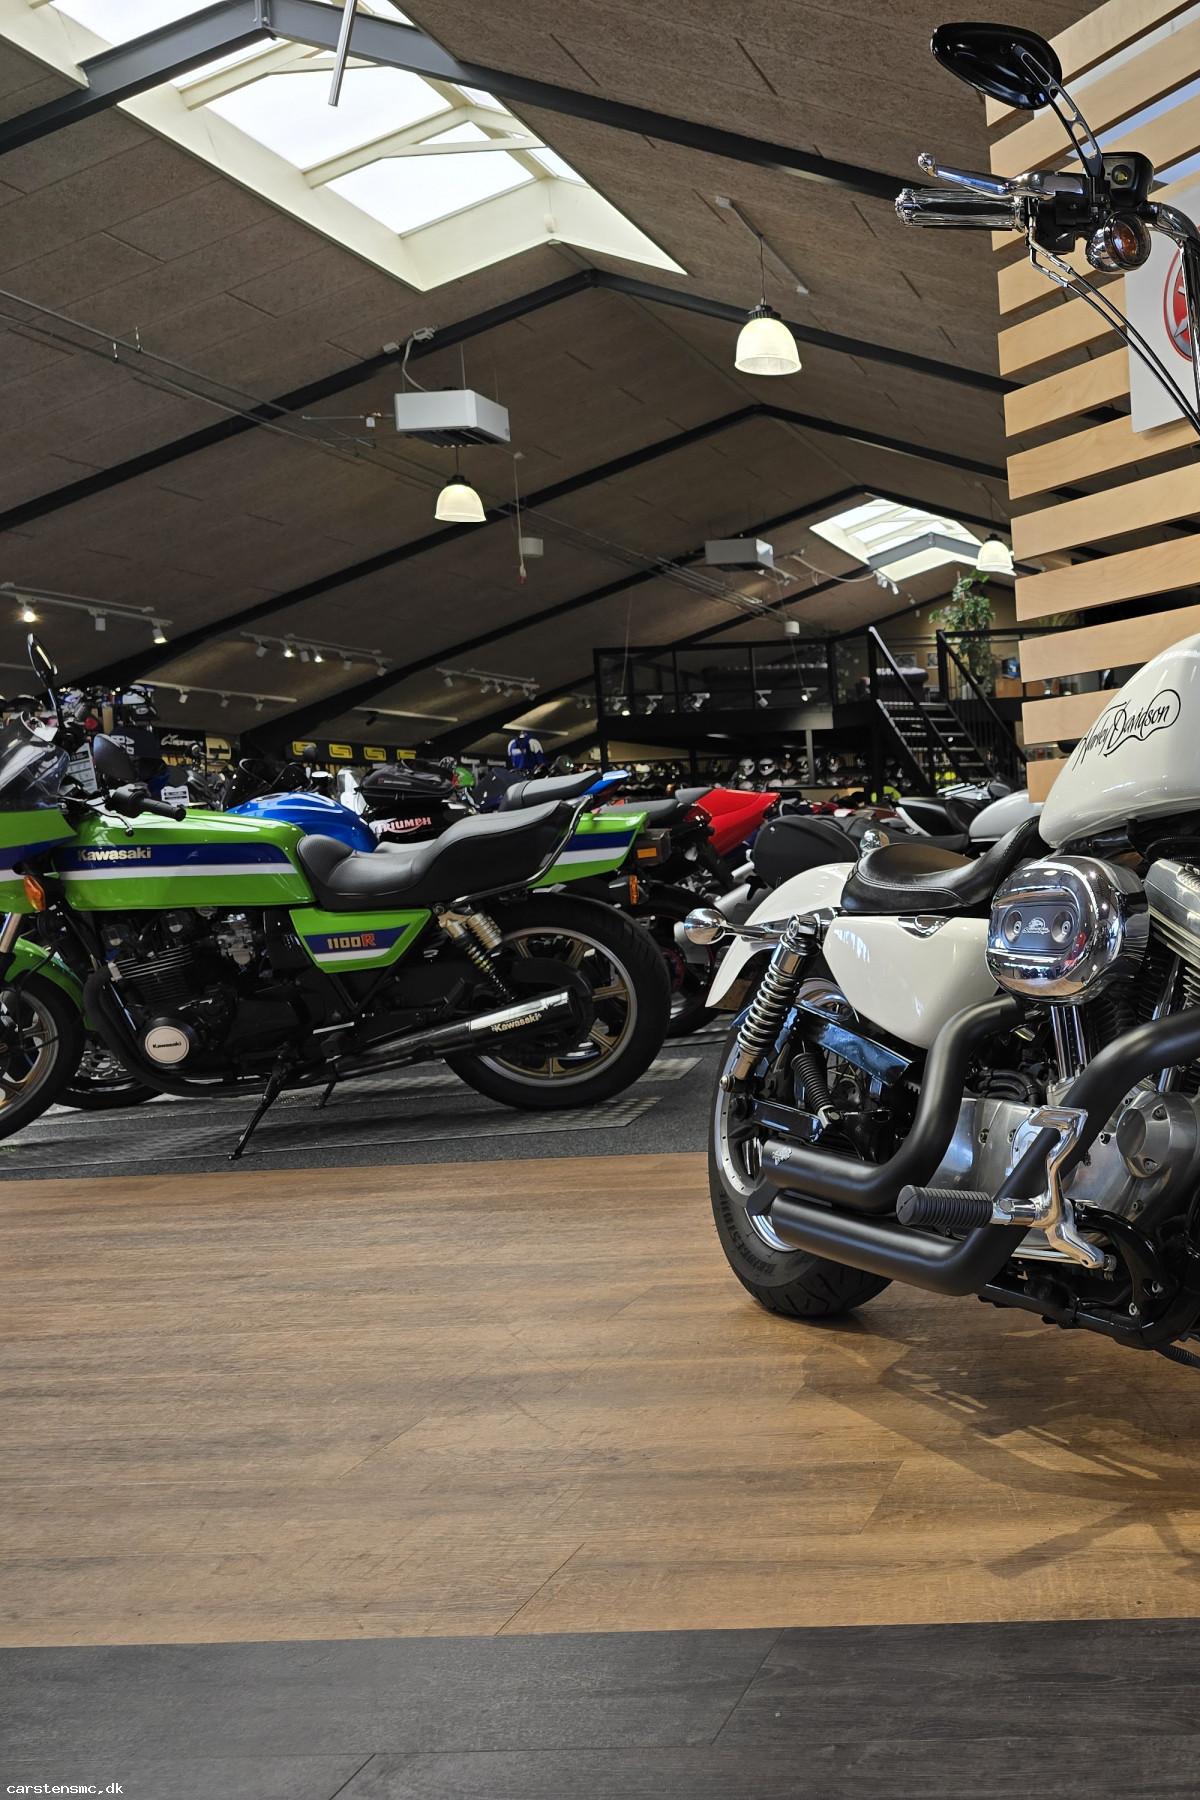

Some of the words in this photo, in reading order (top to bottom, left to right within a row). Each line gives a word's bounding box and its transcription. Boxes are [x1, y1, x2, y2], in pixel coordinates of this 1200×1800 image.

[1104, 689, 1181, 757] Davidson
[376, 817, 432, 833] TRIUMPH
[79, 847, 152, 861] Kawasaki
[326, 933, 377, 949] 1100R
[494, 1013, 541, 1033] Kawasaki
